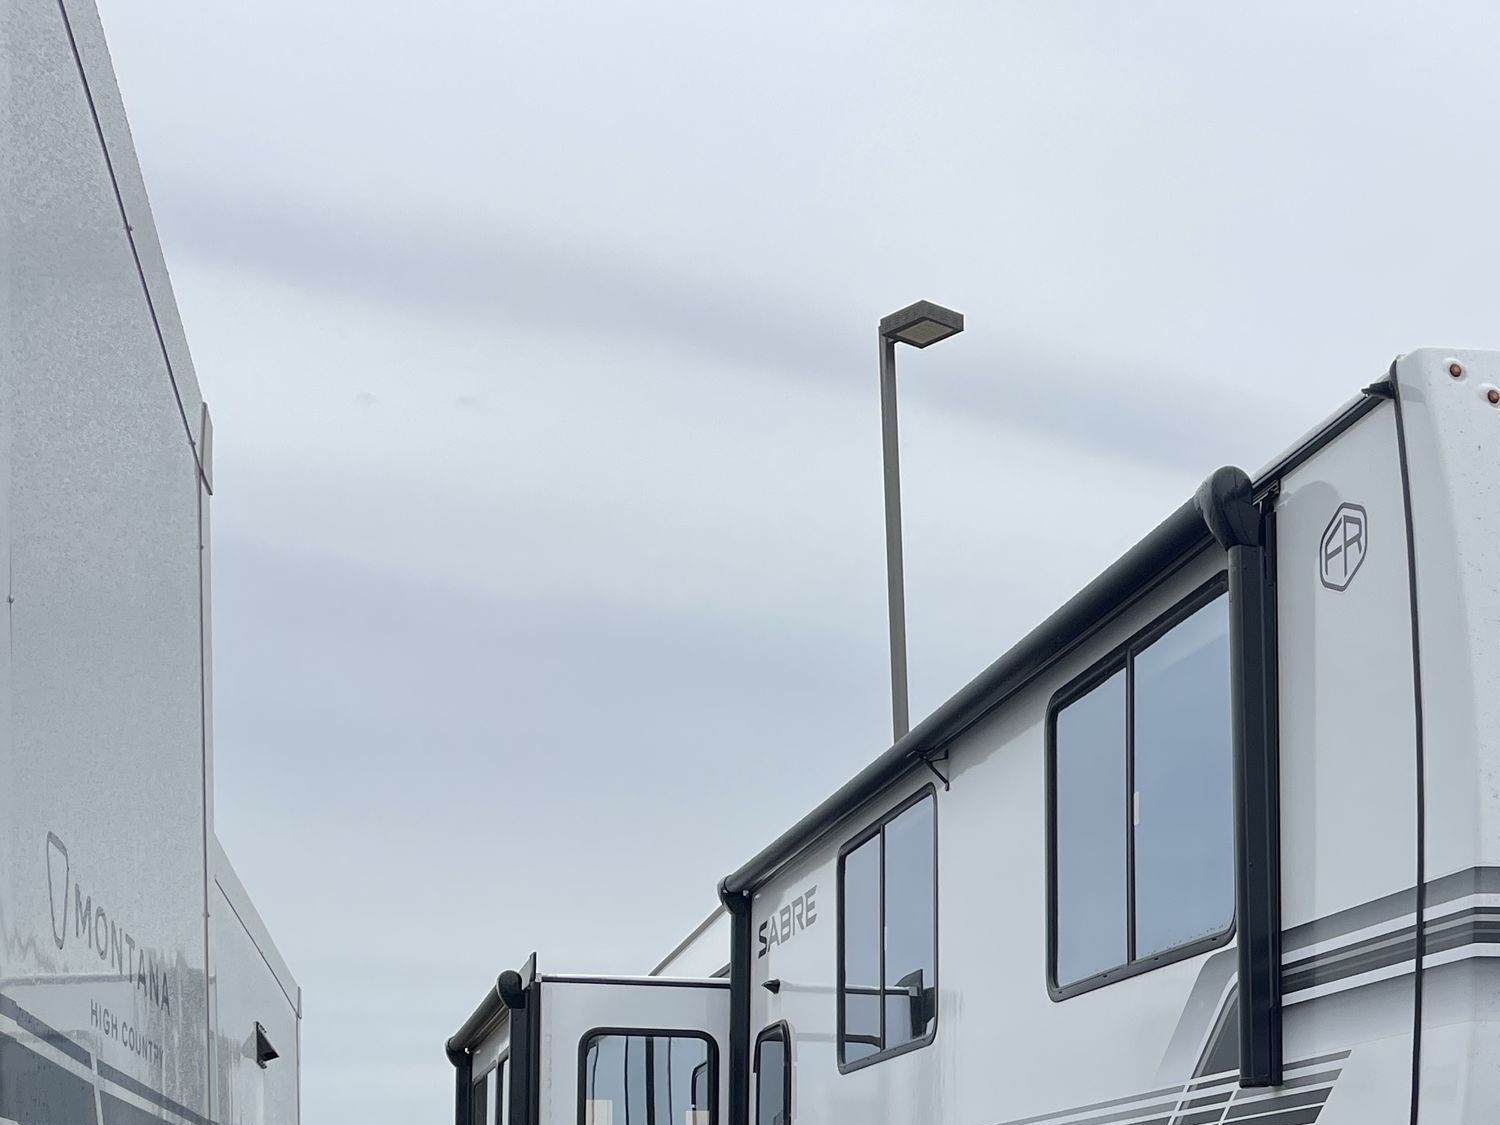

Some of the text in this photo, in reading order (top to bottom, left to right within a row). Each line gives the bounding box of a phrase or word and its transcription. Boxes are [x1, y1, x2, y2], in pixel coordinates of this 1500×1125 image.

[75, 882, 170, 1016] MONTANA
[758, 884, 817, 959] SABRE
[90, 1000, 164, 1069] HIGH COUNTRY
